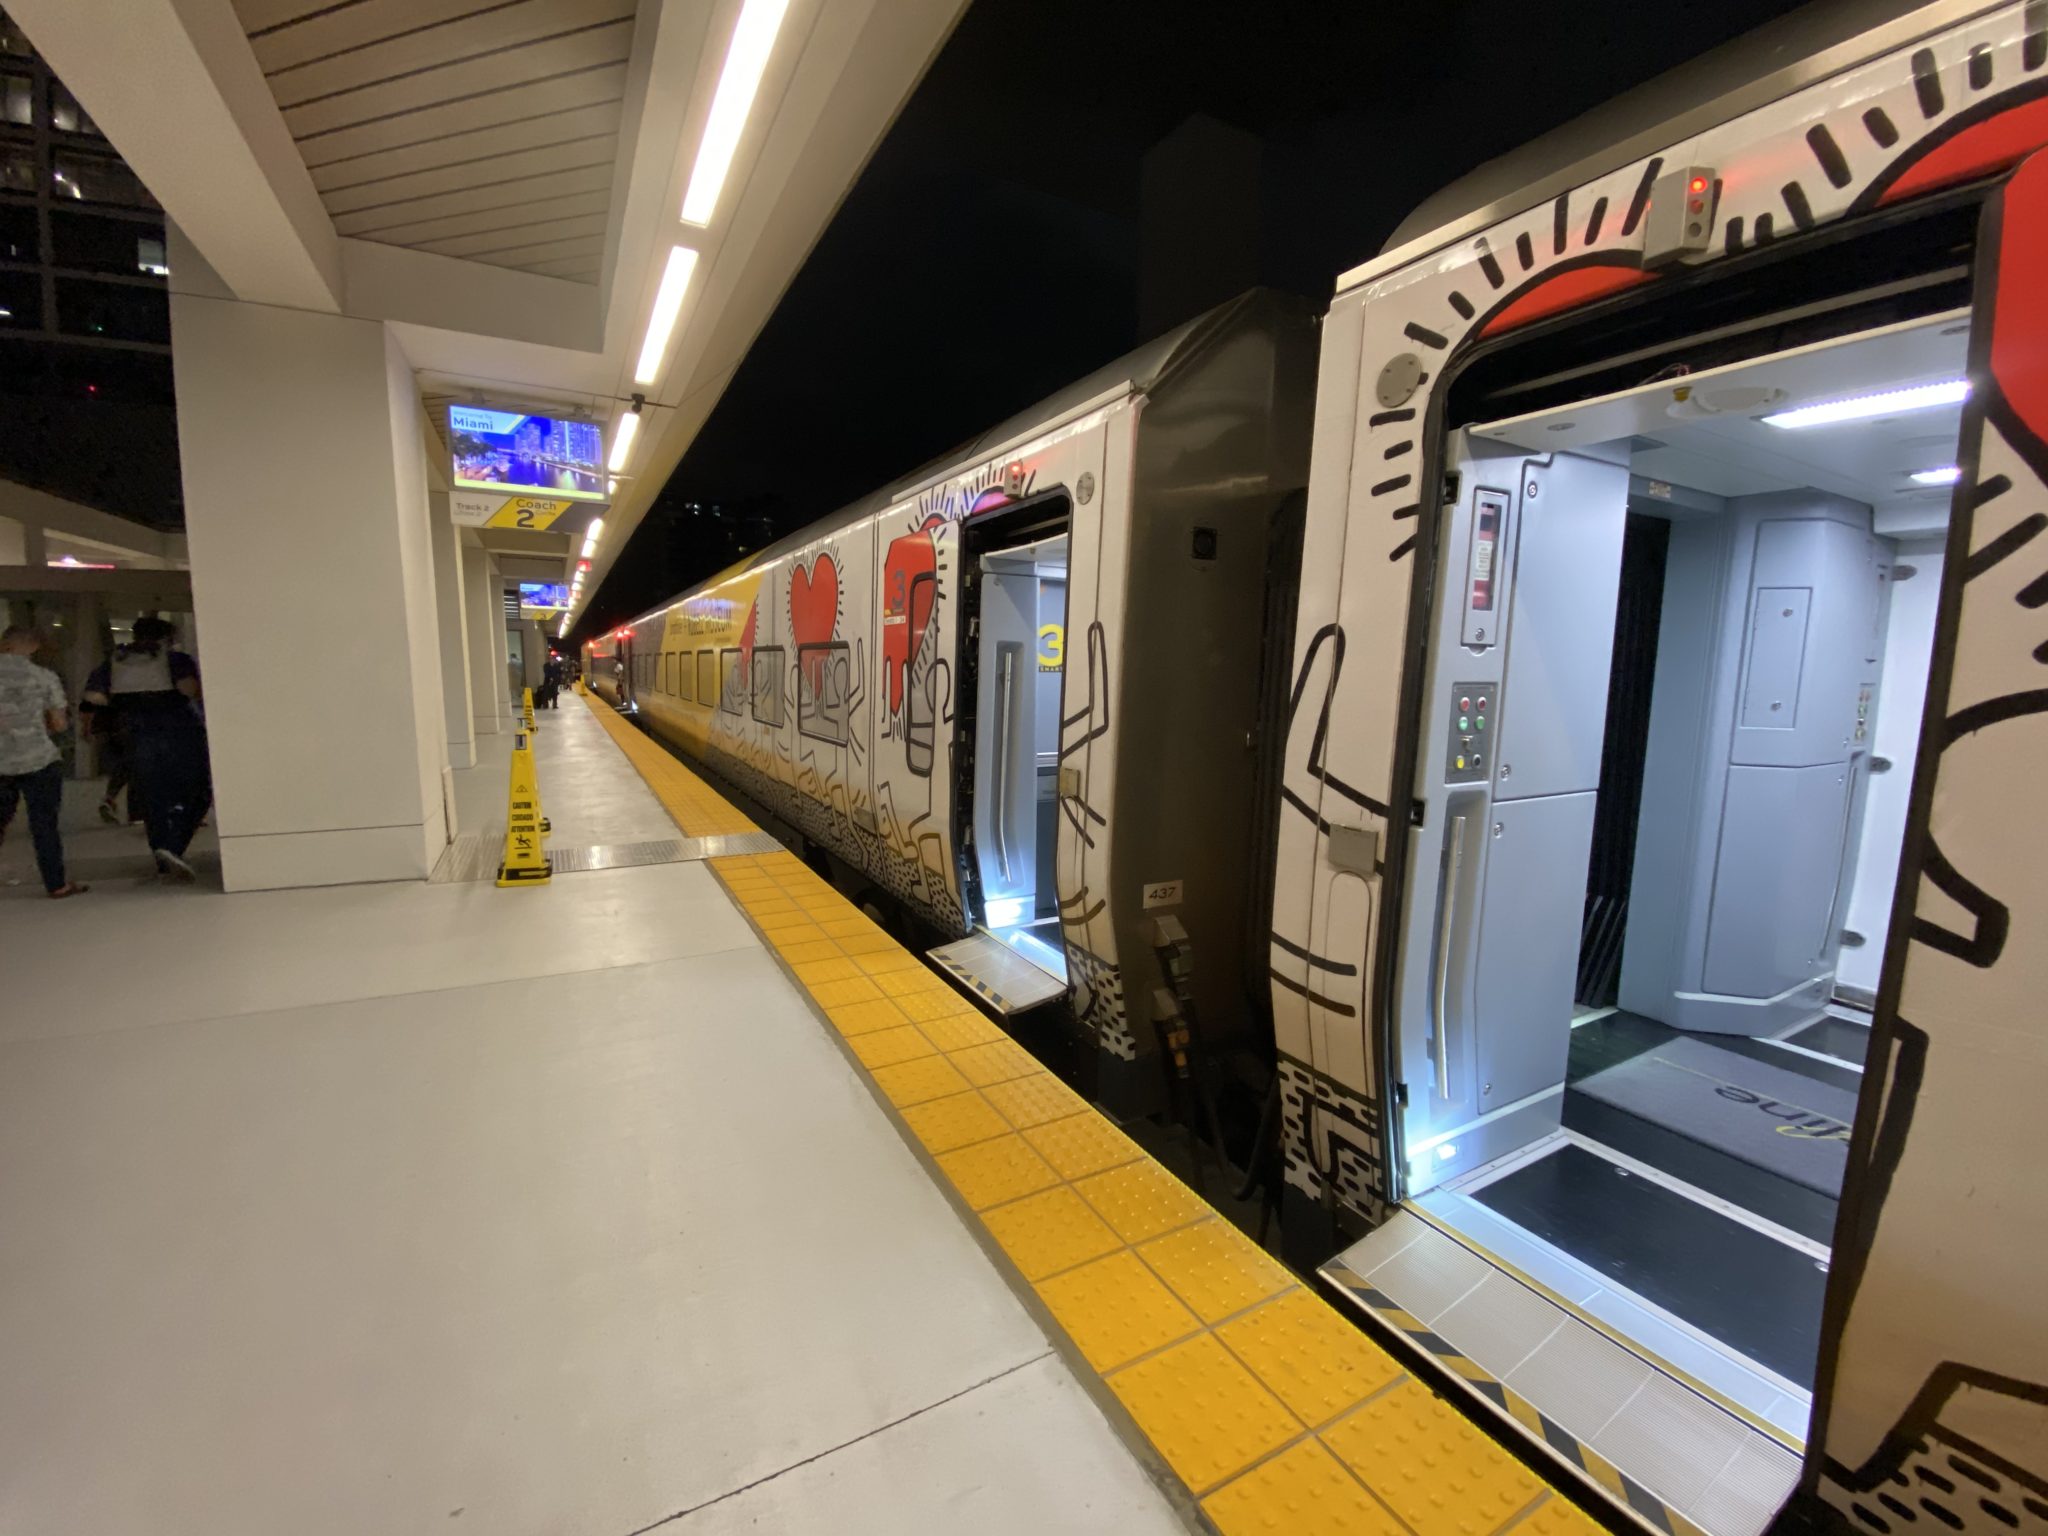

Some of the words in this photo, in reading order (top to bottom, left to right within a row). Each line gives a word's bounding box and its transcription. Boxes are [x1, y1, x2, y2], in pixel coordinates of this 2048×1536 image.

[453, 416, 494, 430] Miami
[456, 502, 482, 511] Track
[516, 499, 557, 511] Coach
[516, 509, 535, 528] 2
[892, 569, 906, 608] 3
[1039, 624, 1064, 667] 3
[1149, 887, 1177, 900] 437
[1714, 1086, 1851, 1142] line
